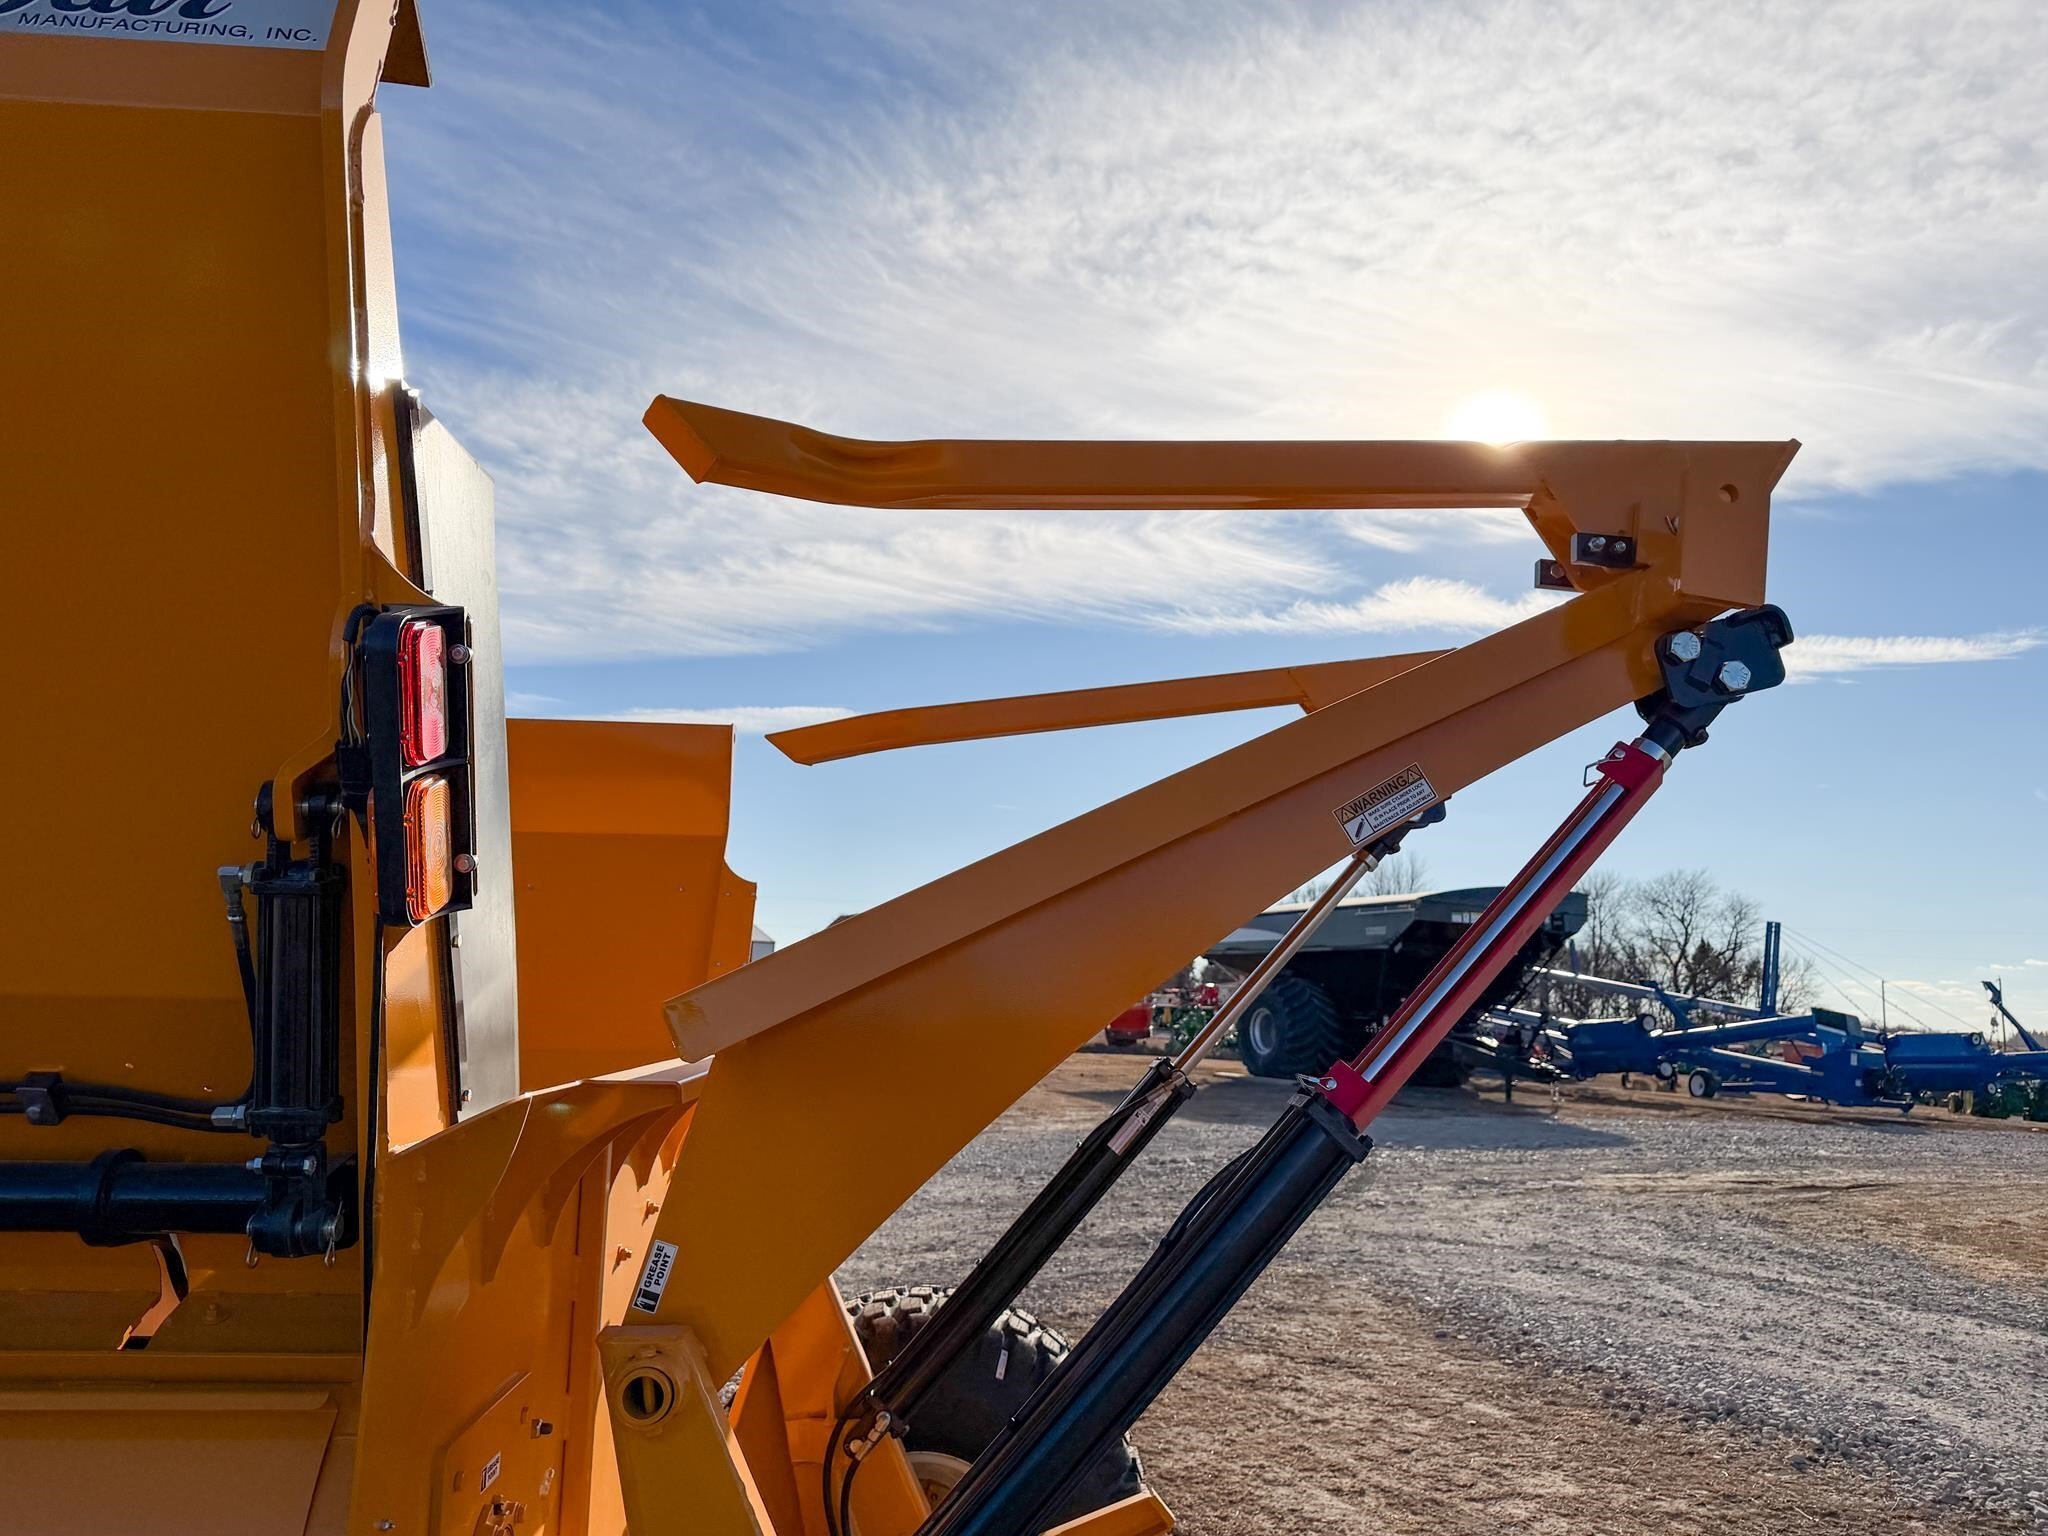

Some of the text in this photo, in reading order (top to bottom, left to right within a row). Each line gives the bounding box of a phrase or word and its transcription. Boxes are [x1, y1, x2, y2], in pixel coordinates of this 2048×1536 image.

[17, 12, 318, 42] MANUFACTURING, INC.
[1347, 775, 1408, 814] WARNING
[1368, 782, 1424, 817] MAKE SURE CYLINDER LOCK
[1383, 805, 1397, 816] PLACE
[643, 1244, 665, 1288] GREASE
[653, 1252, 671, 1287] POINT
